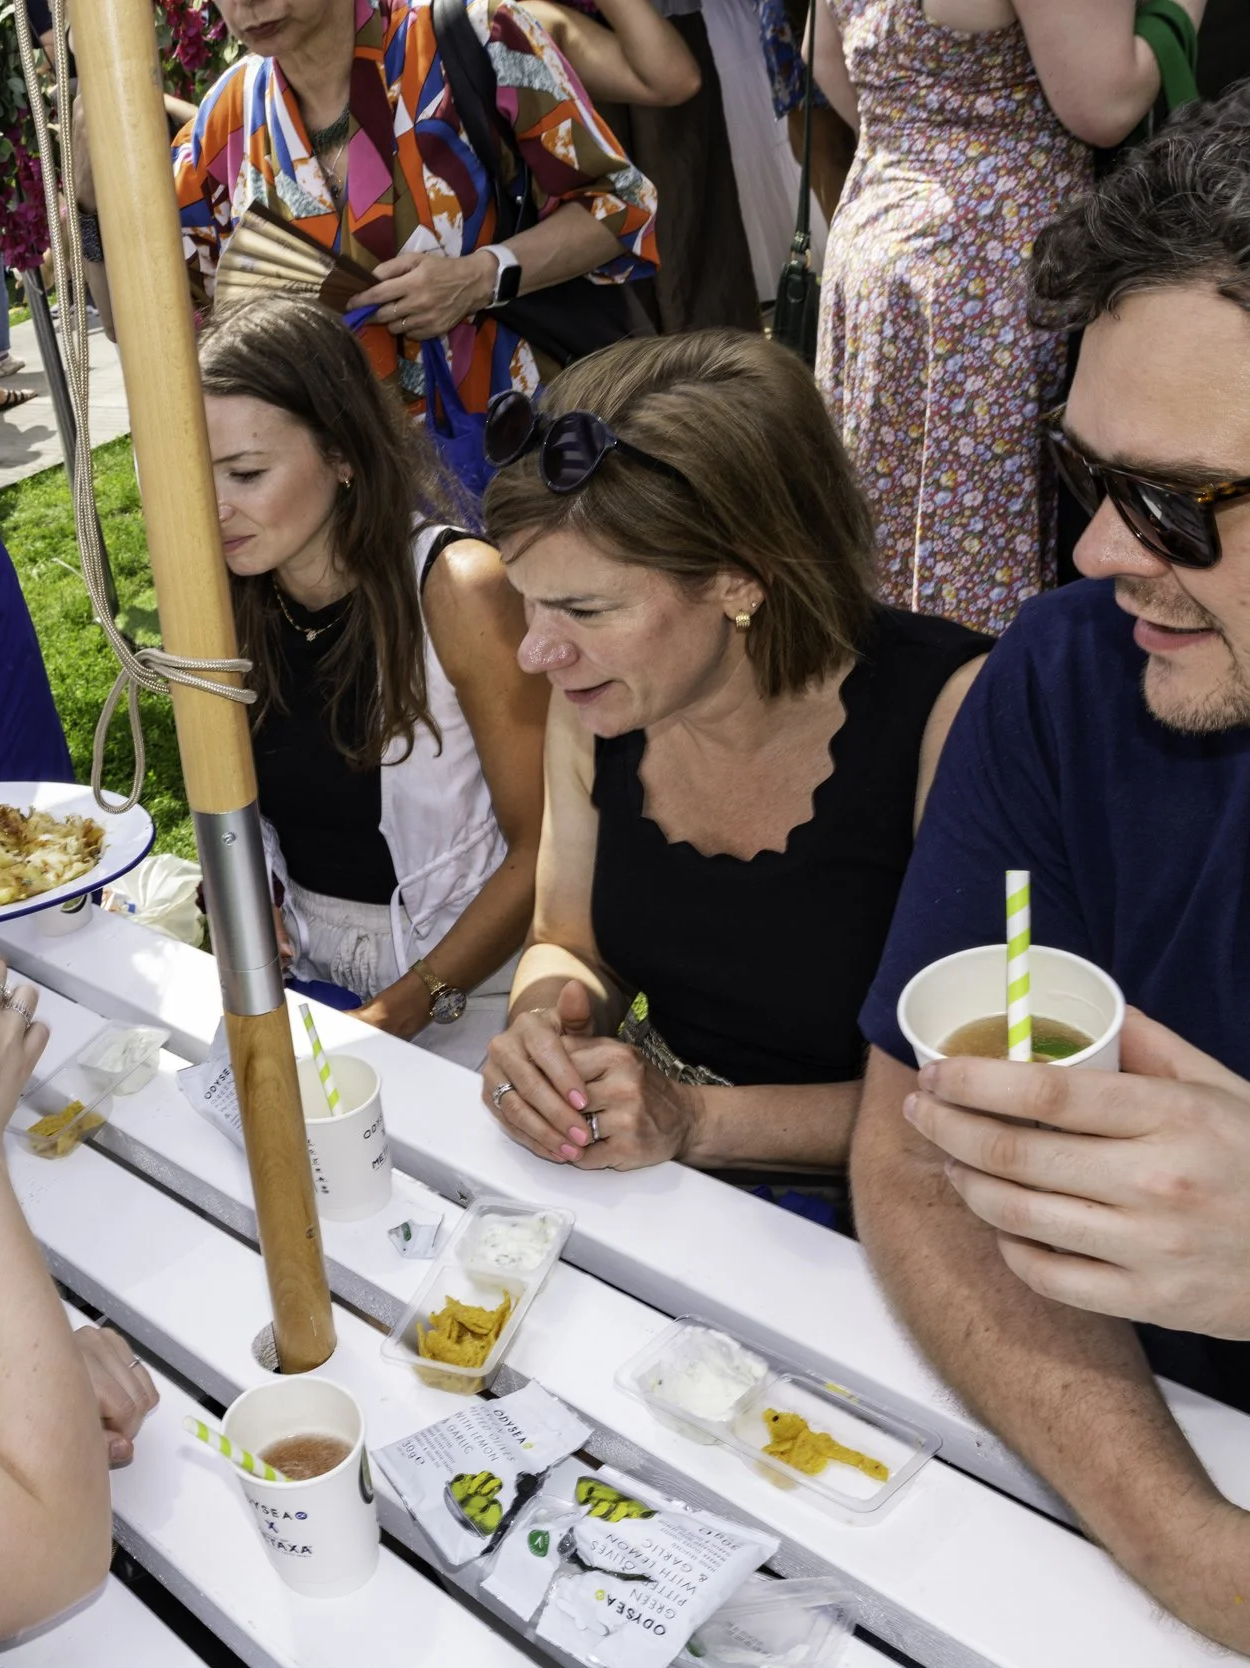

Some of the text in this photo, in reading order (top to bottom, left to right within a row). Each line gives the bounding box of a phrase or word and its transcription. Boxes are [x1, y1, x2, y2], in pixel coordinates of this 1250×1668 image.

[205, 1064, 232, 1099] ODYSE
[493, 1409, 527, 1444] ODYSEA
[470, 1431, 500, 1461] LEMON
[606, 1534, 657, 1569] LEMON
[641, 1538, 693, 1573] GARLIC
[659, 1567, 698, 1596] WITH
[607, 1593, 667, 1636] ODYSEA
[629, 1588, 676, 1620] GREEN
